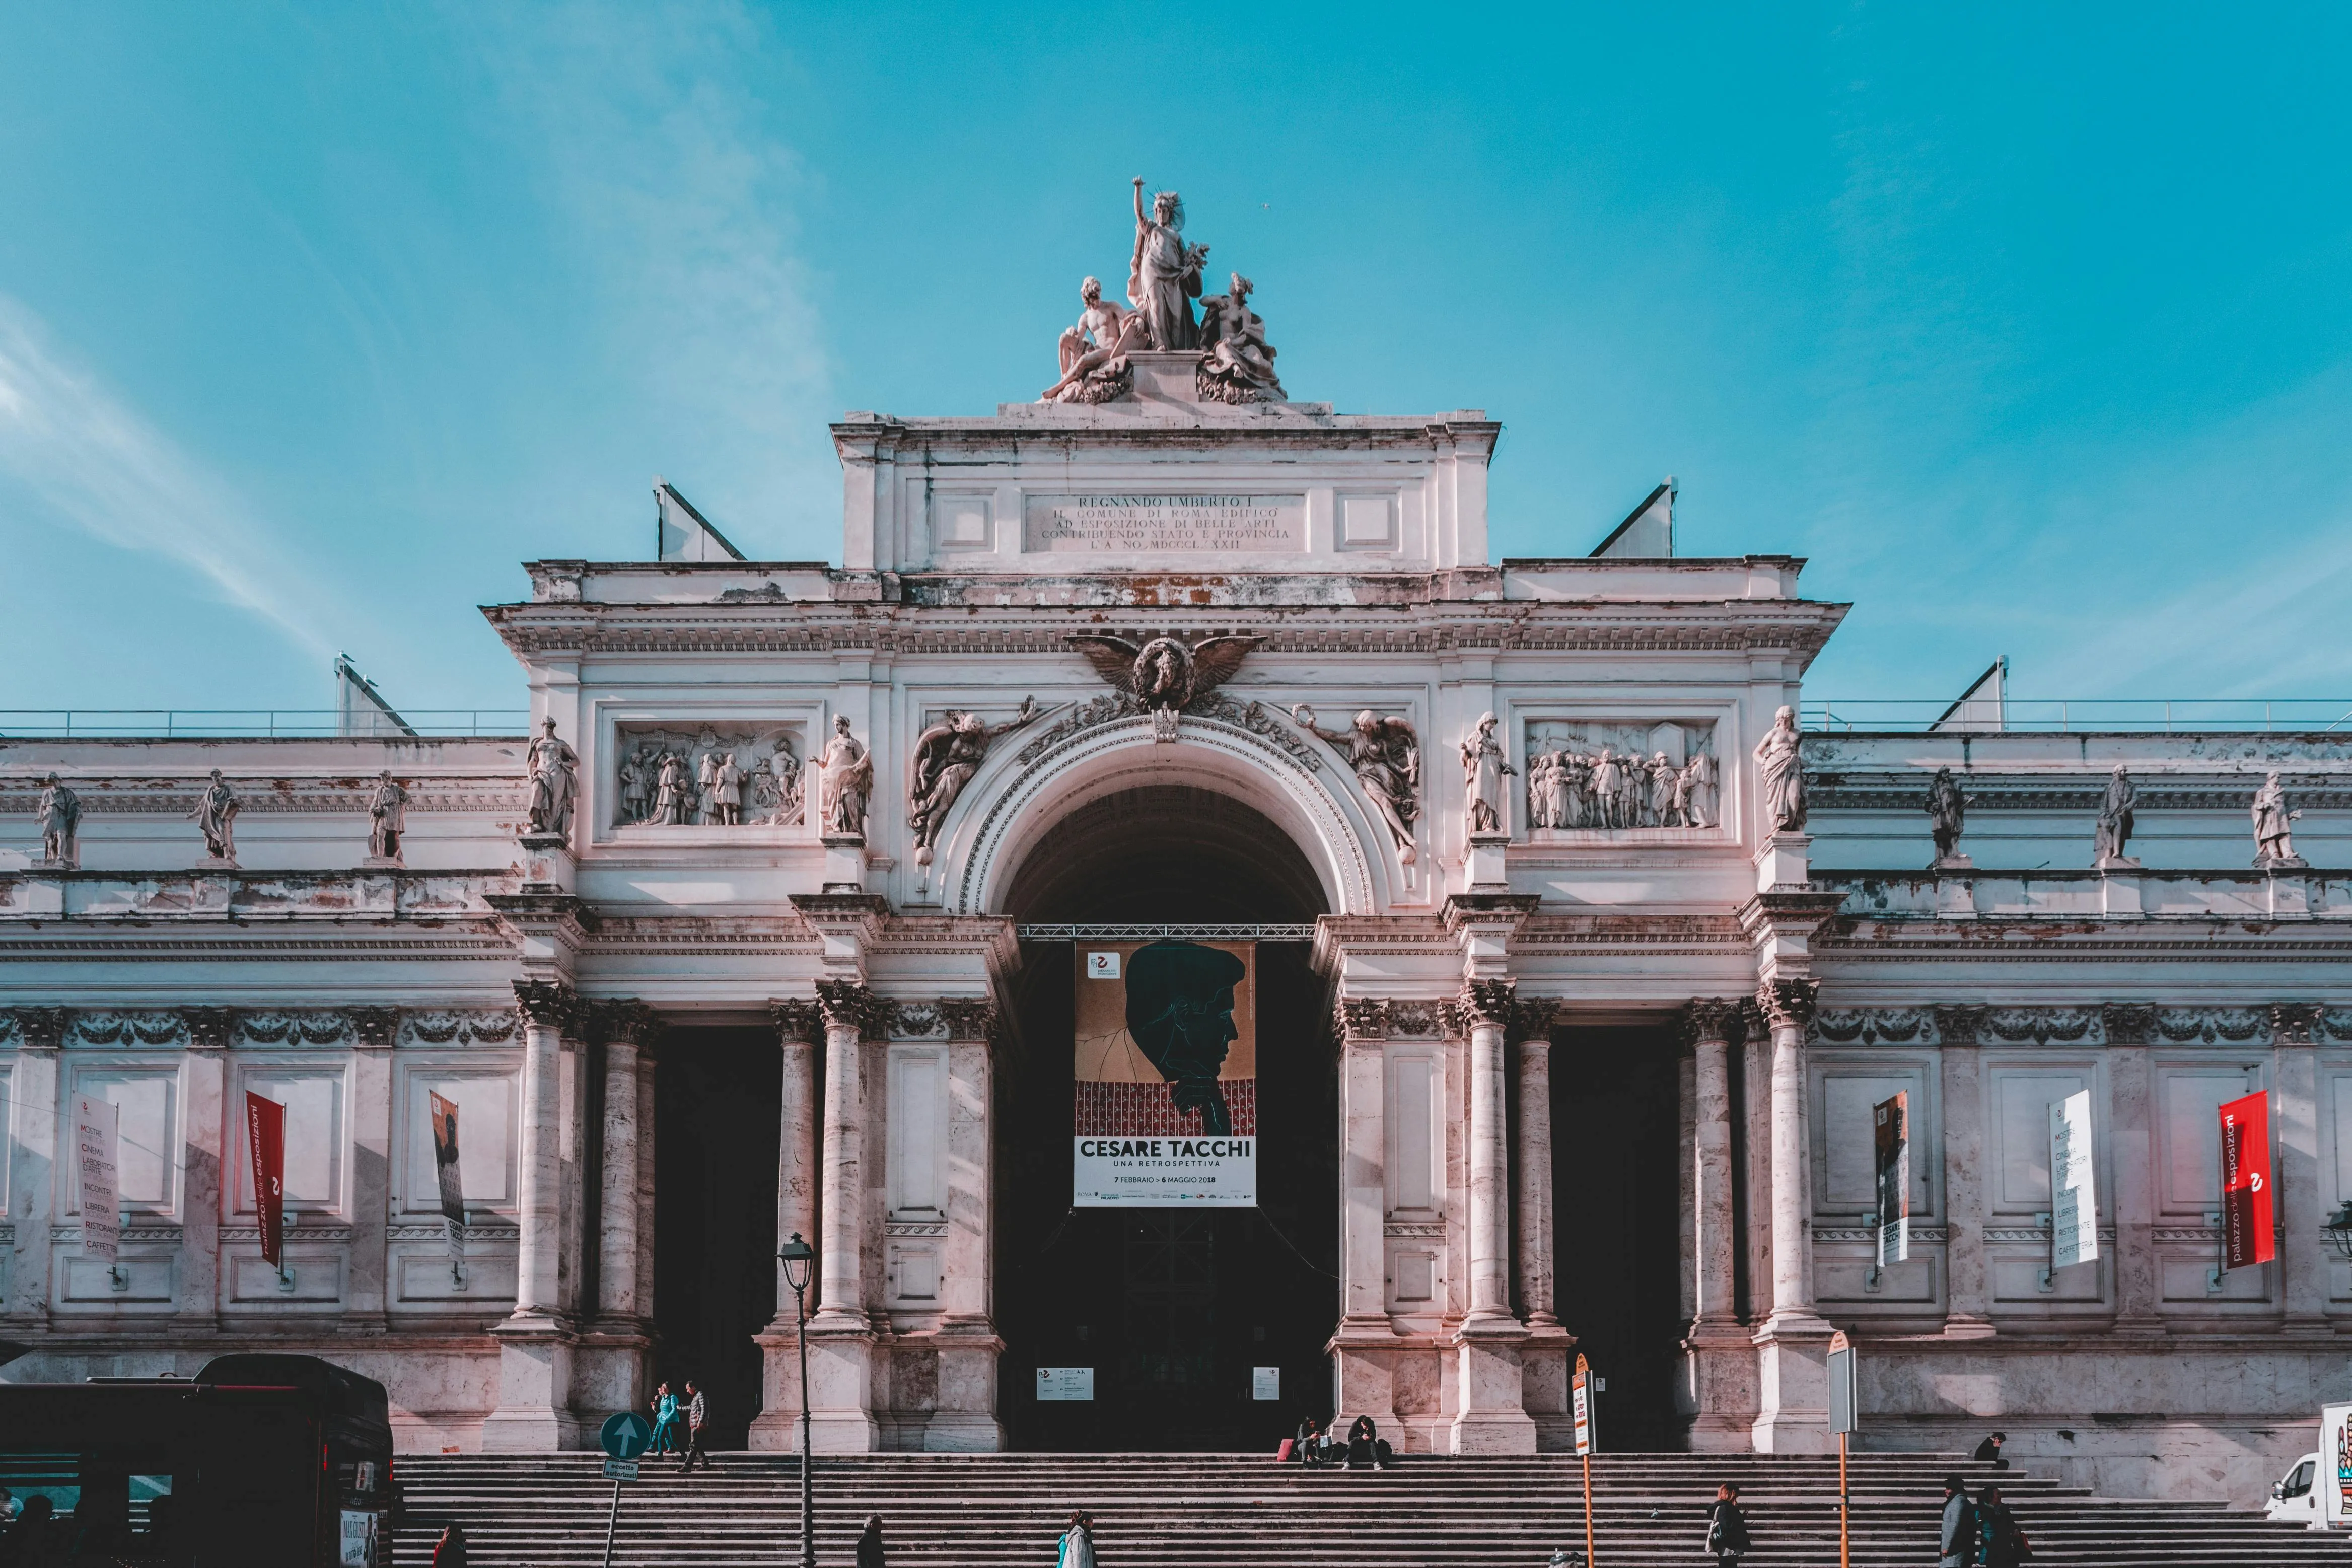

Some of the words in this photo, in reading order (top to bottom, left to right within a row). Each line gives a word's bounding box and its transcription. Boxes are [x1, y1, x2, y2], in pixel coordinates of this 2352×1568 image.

[1079, 497, 1162, 507] REGNANDO
[1169, 496, 1239, 507] UMBERTO
[1247, 496, 1251, 507] I
[1054, 510, 1066, 518] IL
[1077, 509, 1136, 518] COMUNE
[1148, 509, 1160, 517] DI
[1171, 509, 1210, 518] ROMA
[1056, 520, 1072, 528] AD
[1081, 519, 1166, 529] ESPOSIZIONE
[1175, 519, 1186, 528] DI
[1195, 519, 1236, 528] BELLE
[1245, 519, 1275, 528] ARTI
[1042, 530, 1144, 539] CONTRIBUENDO
[1152, 530, 1194, 538] STATO
[1203, 530, 1209, 538] E
[1218, 529, 1289, 538] PROVINCIA
[81, 1124, 103, 1138] MOSTRE
[251, 1104, 262, 1176] esposizioni
[82, 1144, 104, 1157] CINEMA
[1080, 1140, 1162, 1157] CESARE
[1168, 1140, 1250, 1157] TACCHI
[2225, 1114, 2239, 1185] esposizioni
[83, 1164, 102, 1175] D'ARTE
[84, 1182, 112, 1197] INCONTRI
[257, 1177, 265, 1204] delle
[2230, 1186, 2239, 1213] delle
[85, 1201, 110, 1214] LIBRERIA
[1883, 1222, 1900, 1235] CESARE
[2231, 1213, 2242, 1262] palazzo
